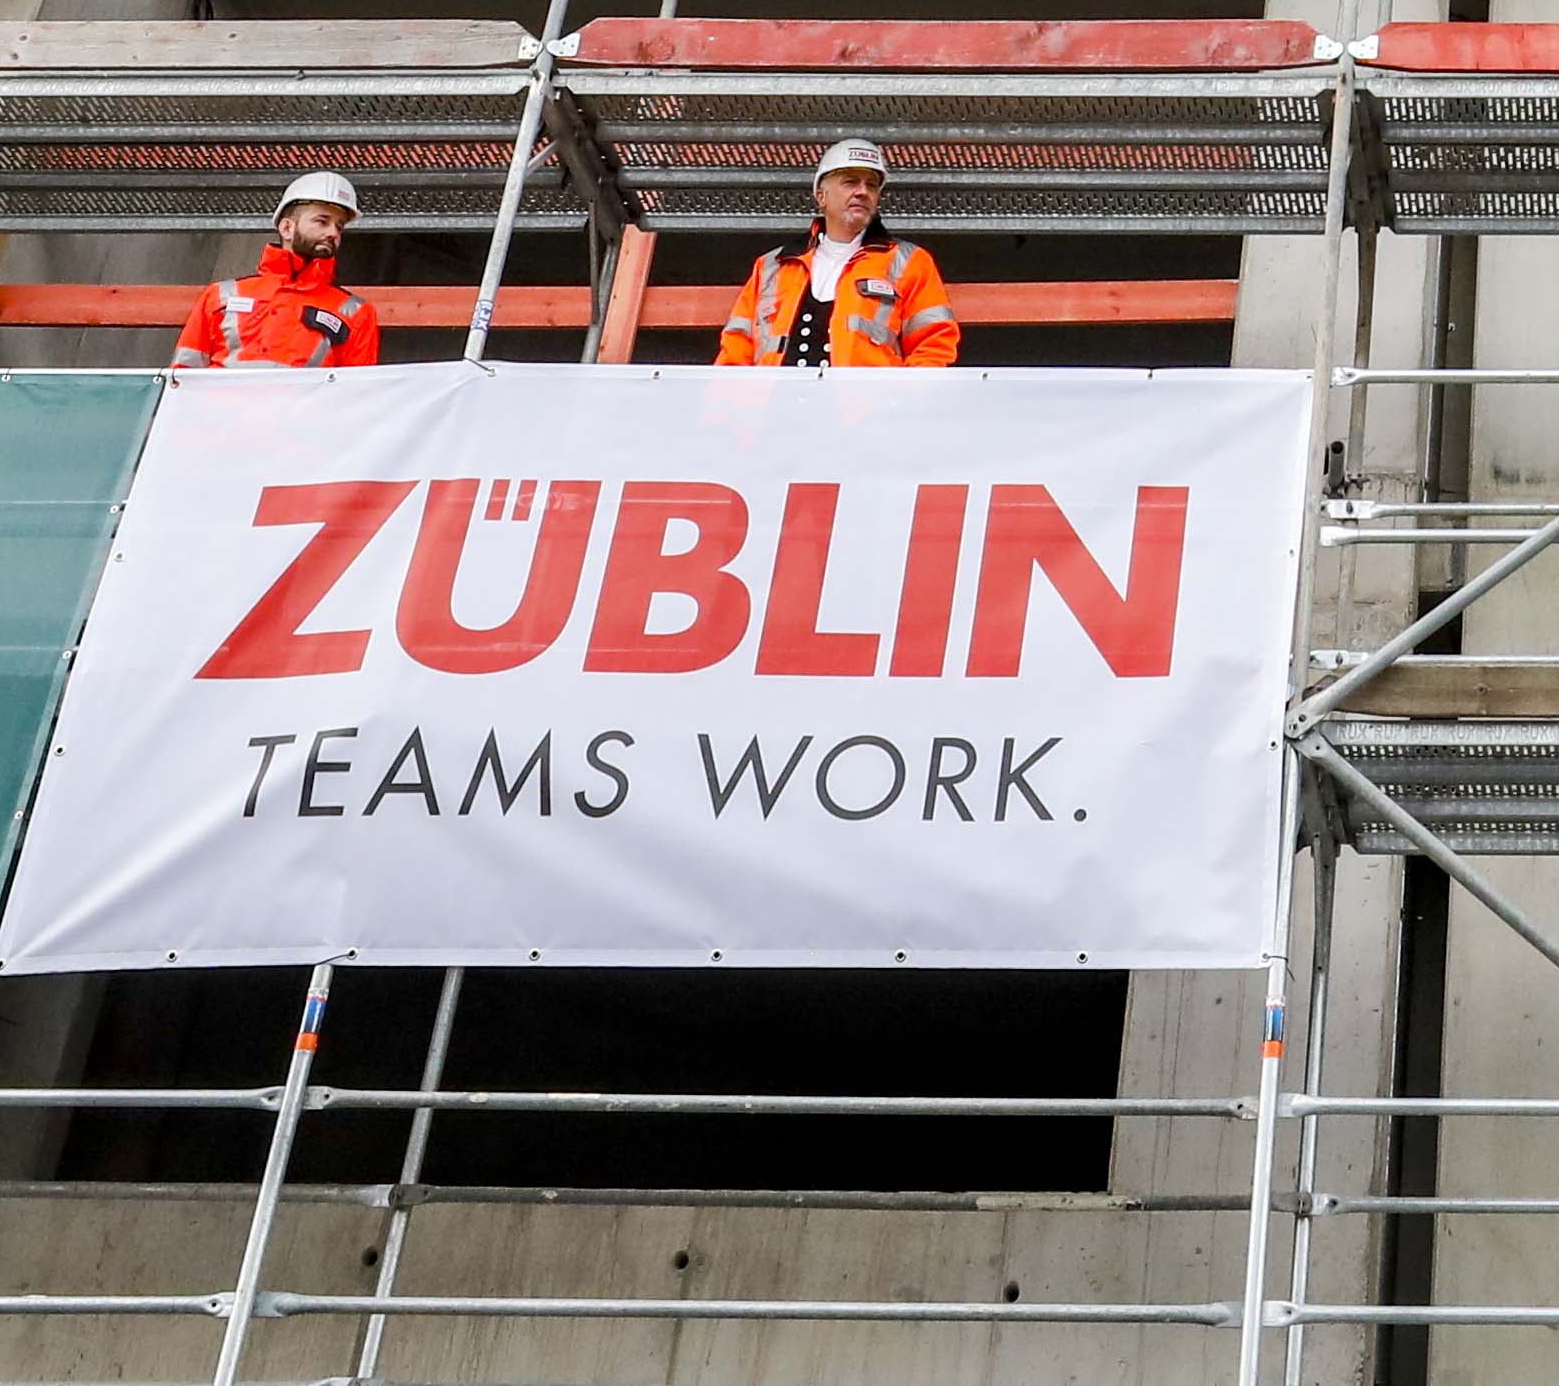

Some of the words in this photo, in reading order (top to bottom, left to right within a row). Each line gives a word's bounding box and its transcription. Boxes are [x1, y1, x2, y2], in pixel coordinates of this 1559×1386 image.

[195, 479, 1190, 681] ZÜBLIN
[243, 727, 636, 820] TEAMS
[698, 734, 1089, 824] WORK.
